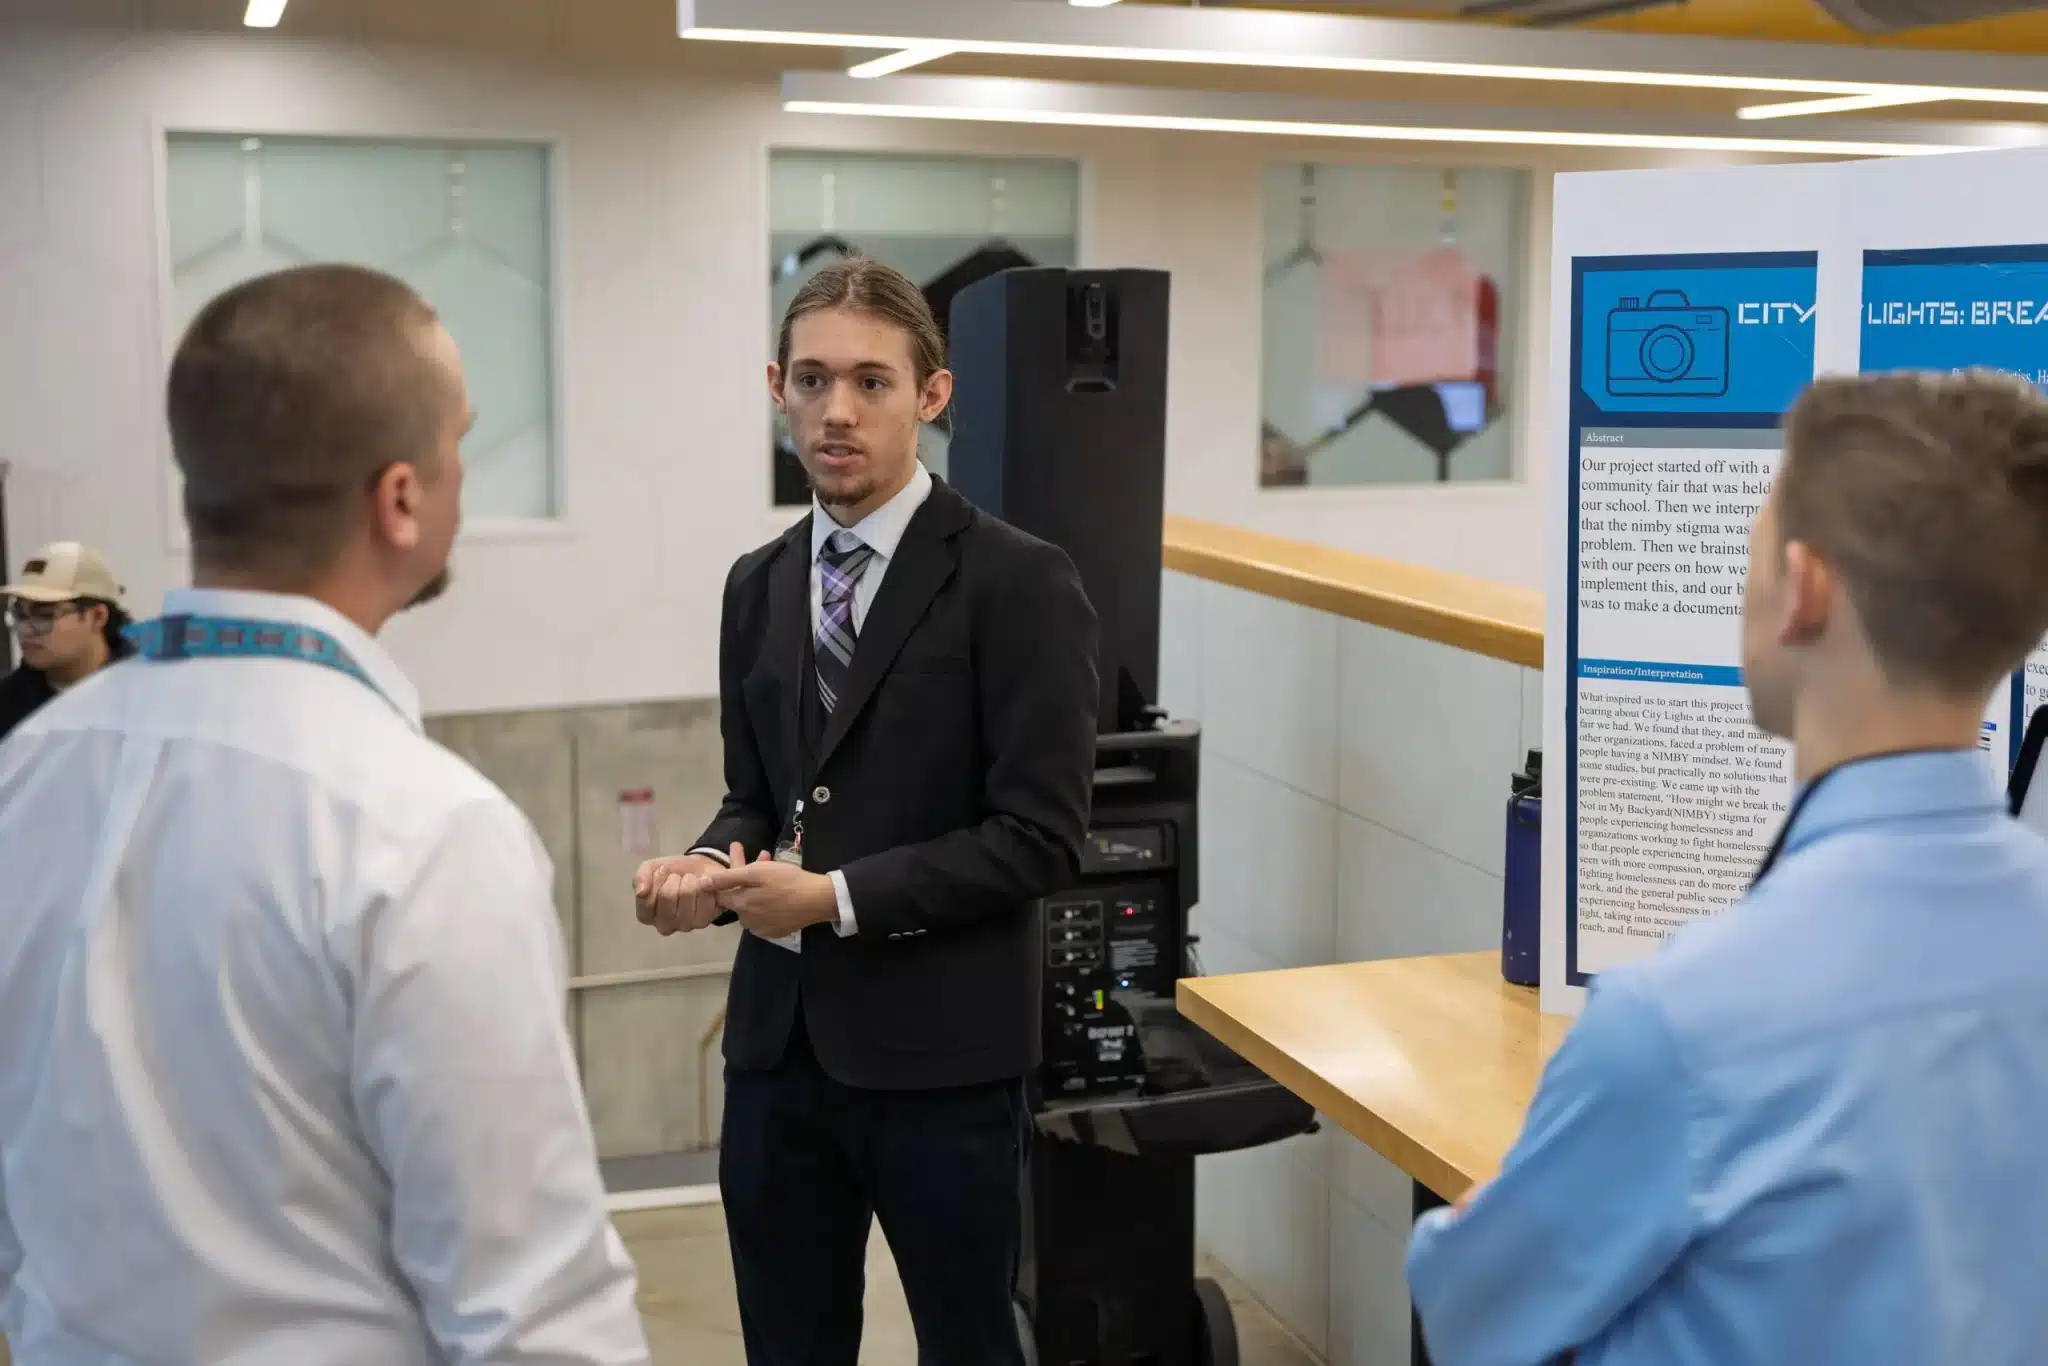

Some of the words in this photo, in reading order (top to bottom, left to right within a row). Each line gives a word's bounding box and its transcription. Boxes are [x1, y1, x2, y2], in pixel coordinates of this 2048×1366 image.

[1738, 302, 1817, 324] CITY
[1868, 301, 1964, 325] LIGHTS:
[1971, 300, 2048, 325] BREA
[1586, 433, 1624, 442] Abstract
[1582, 458, 1606, 471] Our
[1610, 459, 1653, 475] project
[1658, 460, 1700, 472] started
[1705, 460, 1726, 473] off
[1728, 461, 1758, 473] with
[1763, 465, 1770, 473] a
[1582, 479, 1652, 495] community
[1658, 480, 1679, 492] fair
[1684, 480, 1708, 493] that
[1712, 484, 1737, 493] was
[1742, 481, 1771, 494] held
[1581, 502, 1602, 511] our
[1606, 499, 1650, 512] school.
[1655, 500, 1688, 513] Then
[1692, 504, 1711, 513] we
[1716, 501, 1760, 517] interpr
[1581, 518, 1604, 531] that
[1608, 519, 1627, 531] the
[1632, 519, 1671, 535] nimby
[1676, 520, 1719, 536] stigma
[1725, 525, 1750, 534] was
[1581, 539, 1636, 554] problem.
[1641, 540, 1673, 553] Then
[1678, 544, 1696, 553] we
[1701, 541, 1750, 555] brainst
[1581, 558, 1608, 571] with
[1612, 562, 1633, 571] our
[1637, 563, 1670, 575] peers
[1675, 564, 1690, 573] on
[1695, 561, 1723, 574] how
[1728, 566, 1747, 575] we
[1581, 577, 1647, 593] implement
[1651, 579, 1678, 594] this,
[1683, 581, 1706, 593] and
[1711, 585, 1732, 594] our
[1581, 600, 1604, 610] was
[1608, 600, 1620, 610] to
[1624, 599, 1658, 612] make
[1663, 604, 1669, 612] a
[1674, 600, 1744, 615] documenta
[1584, 664, 1703, 679] Inspiration/Interpretation
[2026, 661, 2048, 675] exec
[2025, 684, 2036, 696] to
[1580, 691, 1603, 701] What
[1606, 693, 1641, 705] inspired
[1657, 697, 1666, 705] to
[1669, 698, 1688, 707] start
[1692, 699, 1707, 708] this
[1711, 700, 1743, 712] project
[1580, 705, 1611, 718] hearing
[1615, 708, 1639, 718] about
[1642, 709, 1660, 721] City
[1664, 711, 1693, 723] Lights
[1697, 714, 1705, 722] at
[1708, 714, 1722, 723] the
[1580, 719, 1595, 729] fair
[1613, 721, 1631, 731] had.
[1635, 723, 1650, 732] We
[1653, 724, 1678, 734] found
[1682, 726, 1698, 735] that
[1702, 727, 1724, 739] they,
[1728, 729, 1744, 738] and
[1748, 732, 1773, 742] many
[1580, 733, 1600, 742] other
[1604, 736, 1667, 748] organizations,
[1670, 739, 1695, 749] faced
[1705, 742, 1744, 752] problem
[1748, 744, 1758, 753] of
[1760, 747, 1786, 757] many
[1580, 748, 1608, 758] people
[1612, 748, 1641, 761] having
[1652, 751, 1689, 762] NIMBY
[1692, 754, 1731, 765] mindset.
[1735, 757, 1752, 767] We
[1755, 758, 1782, 769] found
[1580, 762, 1602, 770] some
[1605, 762, 1638, 774] studies,
[1641, 764, 1655, 774] but
[1658, 767, 1705, 780] practically
[1724, 771, 1766, 782] solutions
[1769, 774, 1787, 783] that
[1603, 777, 1658, 790] pre-existing.
[1662, 779, 1677, 789] We
[1680, 783, 1704, 791] came
[1707, 786, 1719, 795] up
[1722, 784, 1742, 794] with
[1745, 786, 1759, 795] the
[1580, 789, 1615, 799] problem
[1618, 792, 1663, 803] statement,
[1666, 794, 1693, 804] “How
[1696, 796, 1723, 808] might
[1743, 799, 1768, 810] break
[1772, 802, 1787, 811] the
[1580, 801, 1596, 810] Not
[1599, 802, 1606, 811] in
[1609, 803, 1624, 815] My
[1628, 804, 1716, 822] Backyard(NIMBY)
[1719, 812, 1749, 824] stigma
[1753, 814, 1766, 824] for
[1580, 816, 1608, 827] people
[1611, 819, 1668, 833] experiencing
[1671, 822, 1733, 835] homelessness
[1737, 828, 1753, 837] and
[1580, 829, 1638, 841] organizations
[1641, 834, 1678, 846] working
[1681, 837, 1689, 845] to
[1693, 837, 1714, 849] fight
[1717, 839, 1772, 852] homelessne
[1592, 842, 1608, 852] that
[1611, 845, 1639, 856] people
[1643, 848, 1700, 862] experiencing
[1580, 857, 1598, 865] seen
[1602, 857, 1620, 866] with
[1623, 861, 1645, 869] more
[1649, 863, 1705, 875] compassion,
[1708, 868, 1758, 878] organizati
[1580, 868, 1613, 882] fighting
[1617, 871, 1677, 885] homelessness
[1698, 878, 1709, 888] do
[1713, 882, 1737, 890] more
[1580, 883, 1603, 893] work,
[1607, 885, 1622, 894] and
[1625, 886, 1639, 895] the
[1642, 890, 1674, 899] general
[1677, 891, 1705, 902] public
[1708, 896, 1728, 904] sees
[1580, 896, 1635, 910] experiencing
[1638, 900, 1700, 914] homelessness
[1702, 906, 1711, 915] in
[1580, 907, 1601, 920] light,
[1604, 911, 1631, 924] taking
[1635, 913, 1651, 923] into
[1654, 918, 1685, 927] accoun
[1580, 923, 1605, 933] reach,
[1608, 925, 1623, 934] and
[1627, 926, 1664, 939] financial
